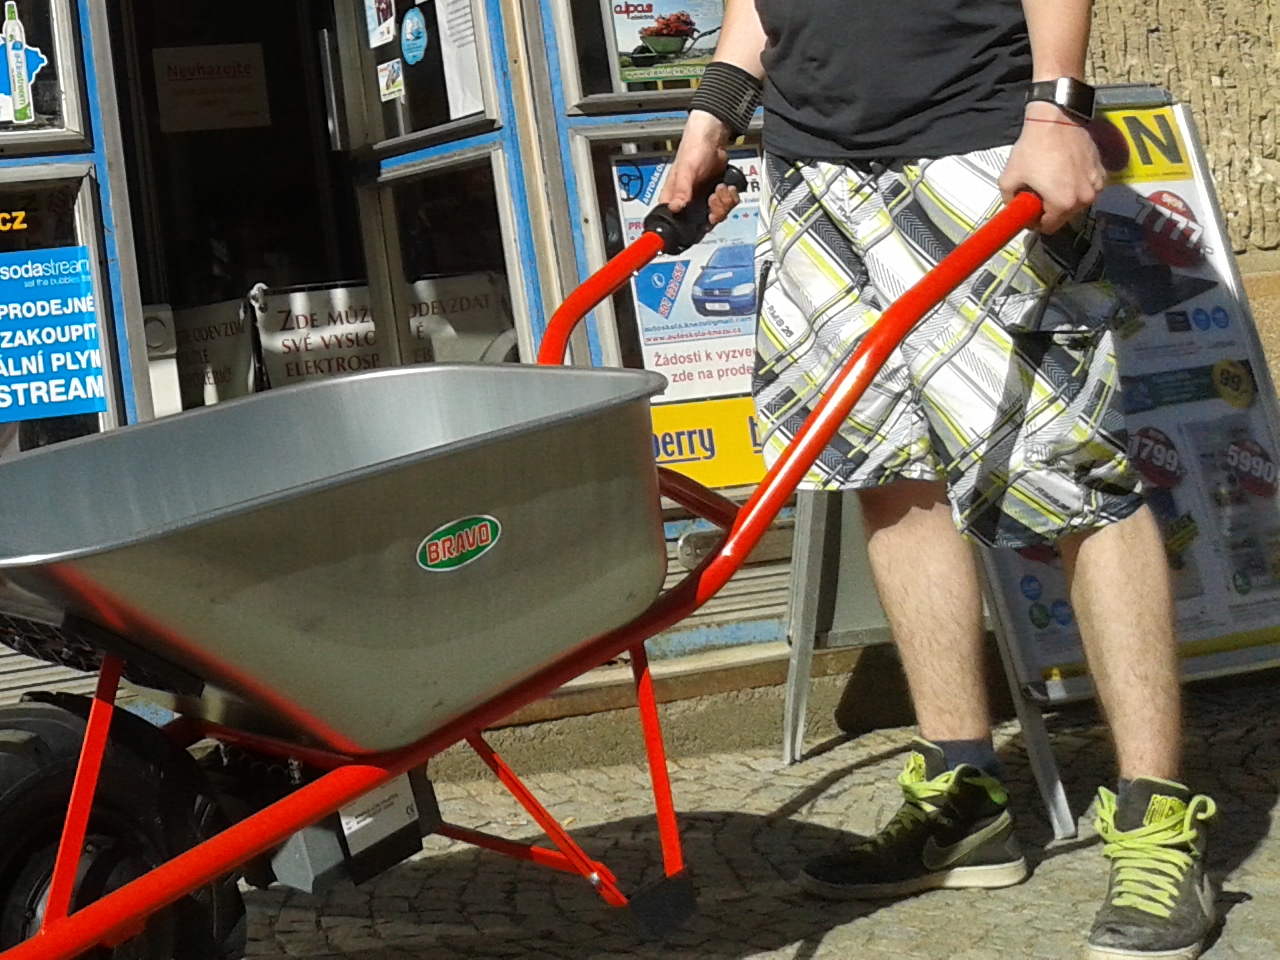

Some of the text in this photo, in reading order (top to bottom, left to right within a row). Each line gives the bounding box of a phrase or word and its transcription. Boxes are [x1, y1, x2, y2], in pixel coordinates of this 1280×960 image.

[277, 309, 320, 332] ZDE
[327, 305, 371, 327] MŮŽ
[0, 322, 97, 349] ZAKOUPIT
[282, 330, 377, 354] SVÉ VYSLO
[285, 353, 380, 378] ELEKTROSP
[653, 349, 702, 367] Žádosti
[704, 349, 714, 362] k
[671, 364, 754, 383] zde na prode
[426, 521, 491, 565] BRAVO
